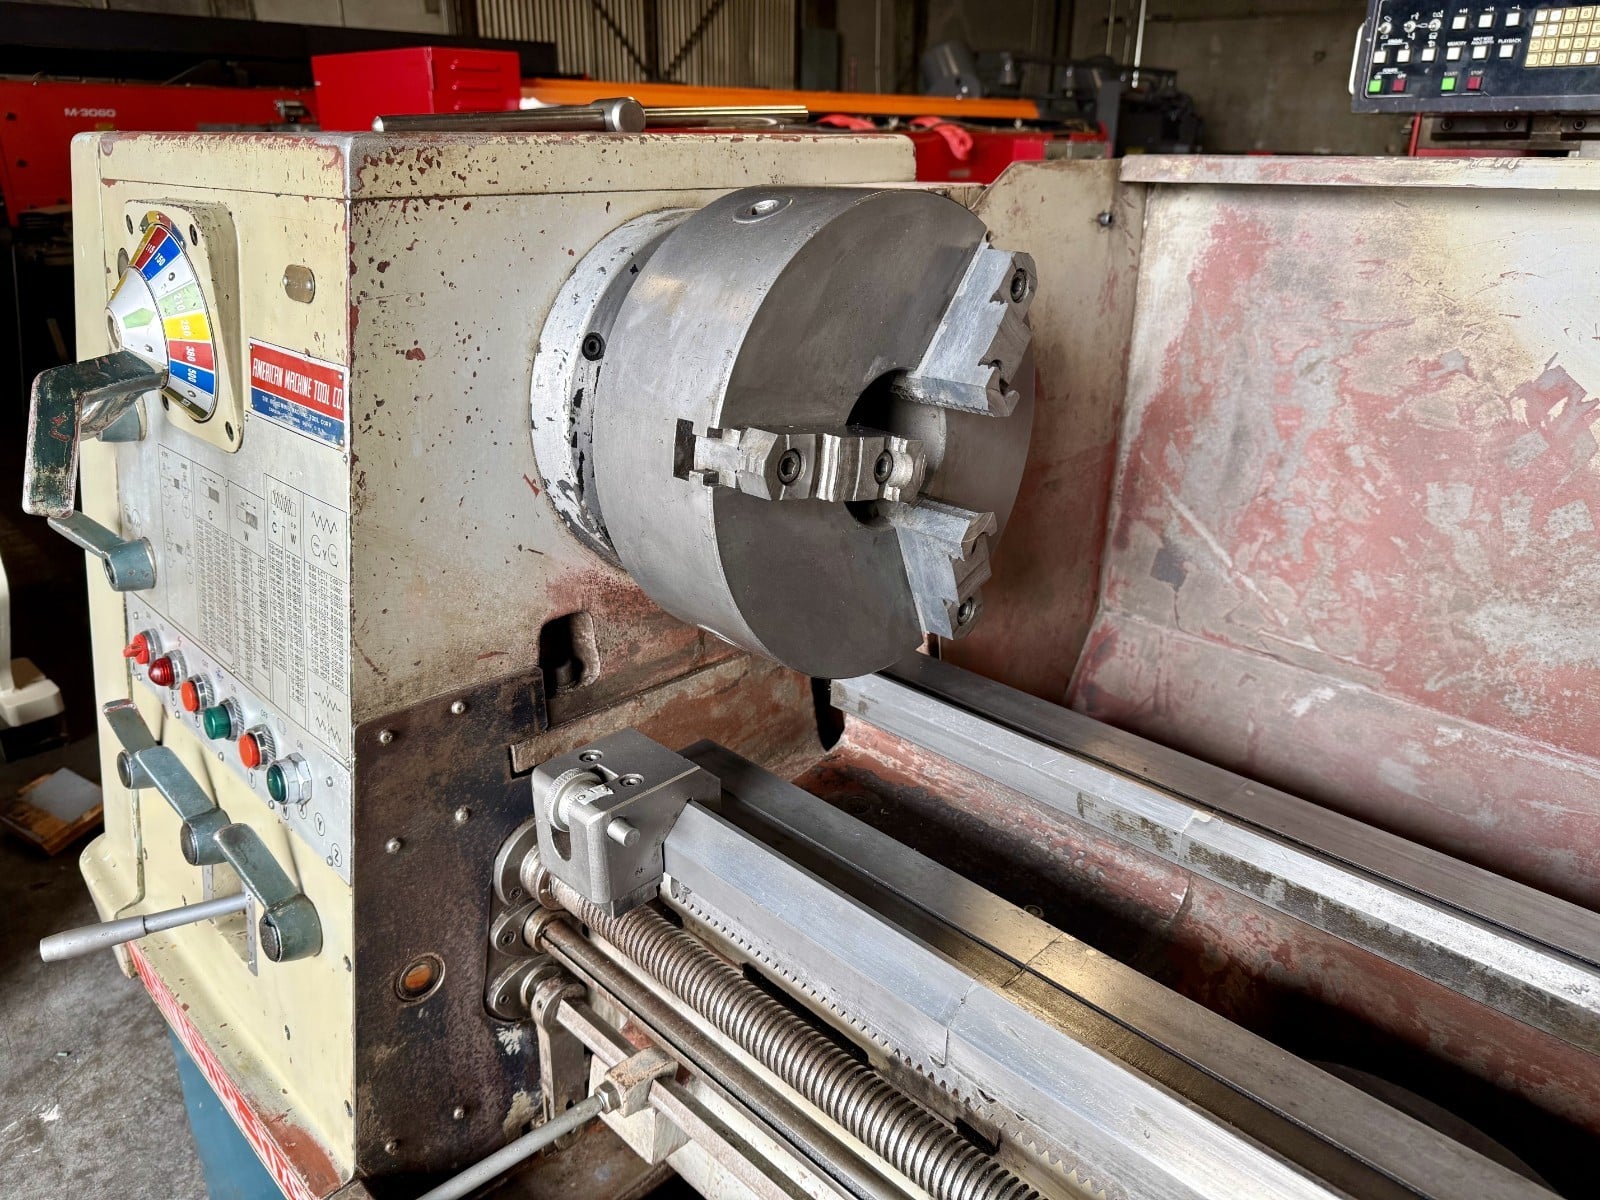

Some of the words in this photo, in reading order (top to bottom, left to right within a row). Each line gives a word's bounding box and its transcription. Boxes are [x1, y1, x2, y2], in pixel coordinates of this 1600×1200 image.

[64, 108, 116, 117] M-3060
[145, 242, 156, 254] 115
[154, 252, 166, 267] 150
[174, 293, 186, 311] 210
[187, 367, 197, 384] 500
[251, 357, 284, 388] AMERICAN
[284, 369, 313, 399] MACHINE
[313, 379, 331, 406] TOOL
[332, 386, 344, 411] CO.
[271, 521, 278, 534] C
[290, 532, 297, 545] W
